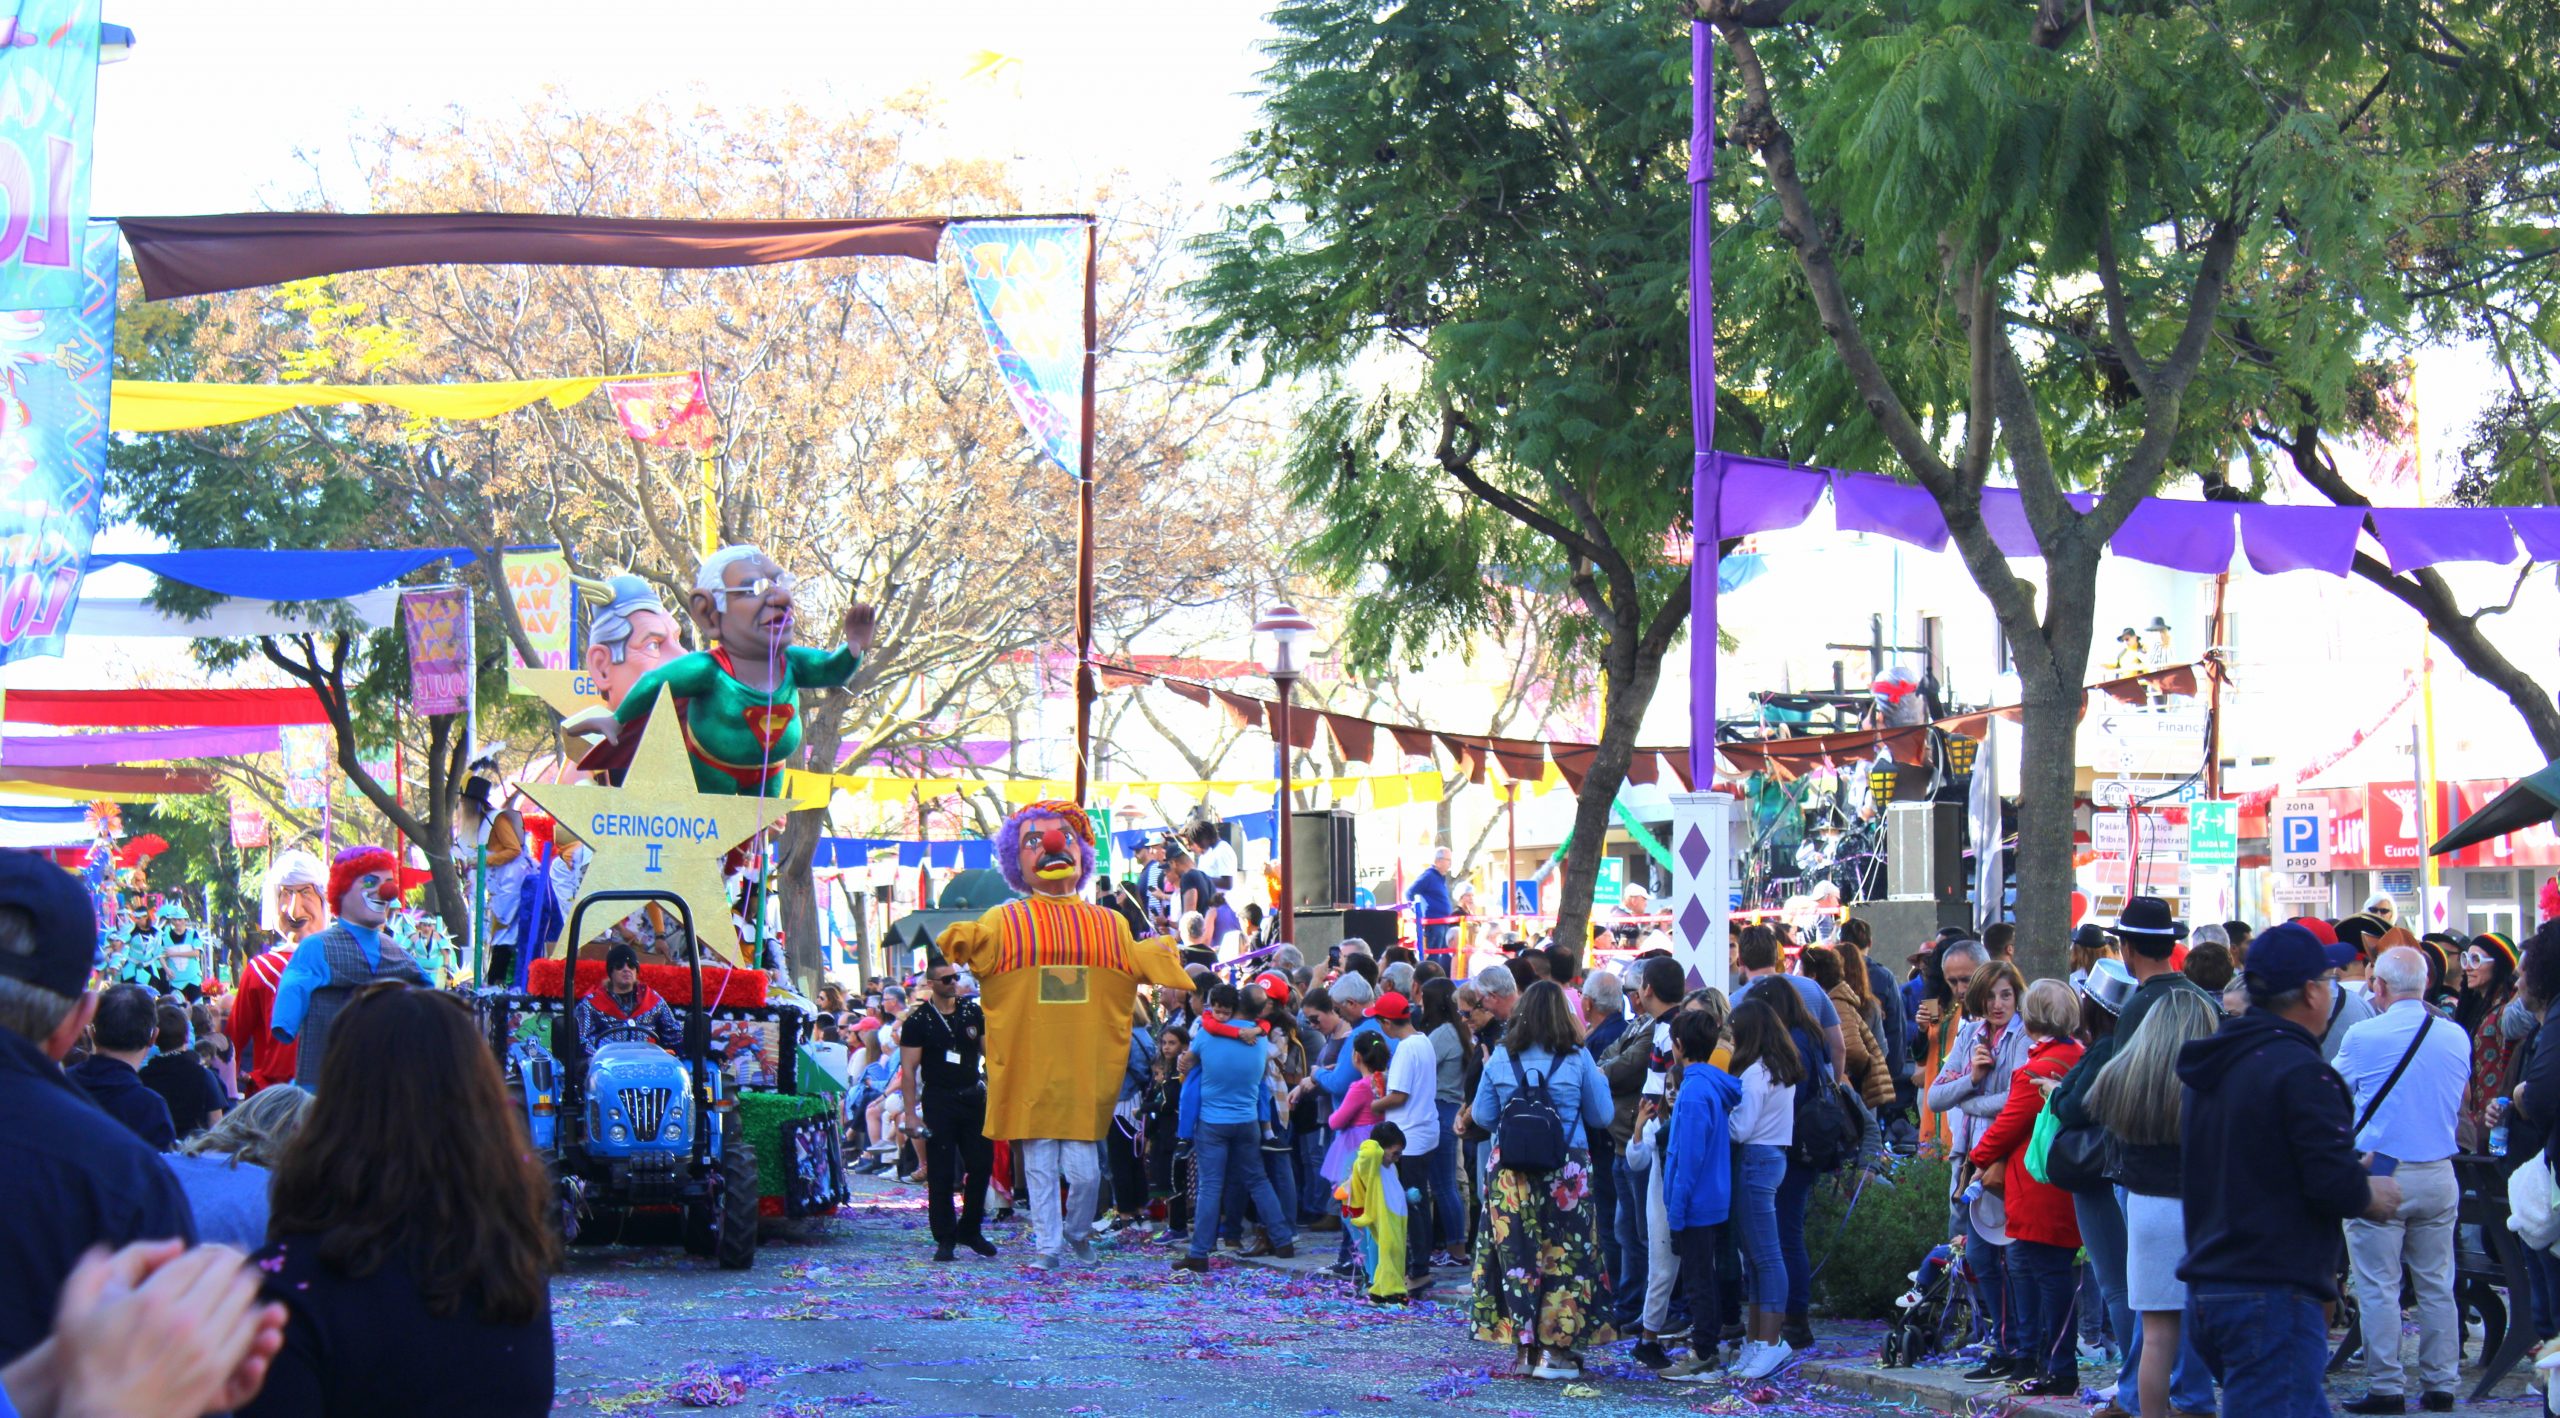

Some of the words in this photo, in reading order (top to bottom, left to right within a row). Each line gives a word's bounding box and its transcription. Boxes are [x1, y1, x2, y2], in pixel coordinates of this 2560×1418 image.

[574, 676, 601, 695] GE
[2286, 803, 2314, 811] zona
[591, 813, 719, 844] GERINGONÇA
[2289, 818, 2313, 851] P
[645, 843, 663, 873] II
[2286, 857, 2317, 867] pago
